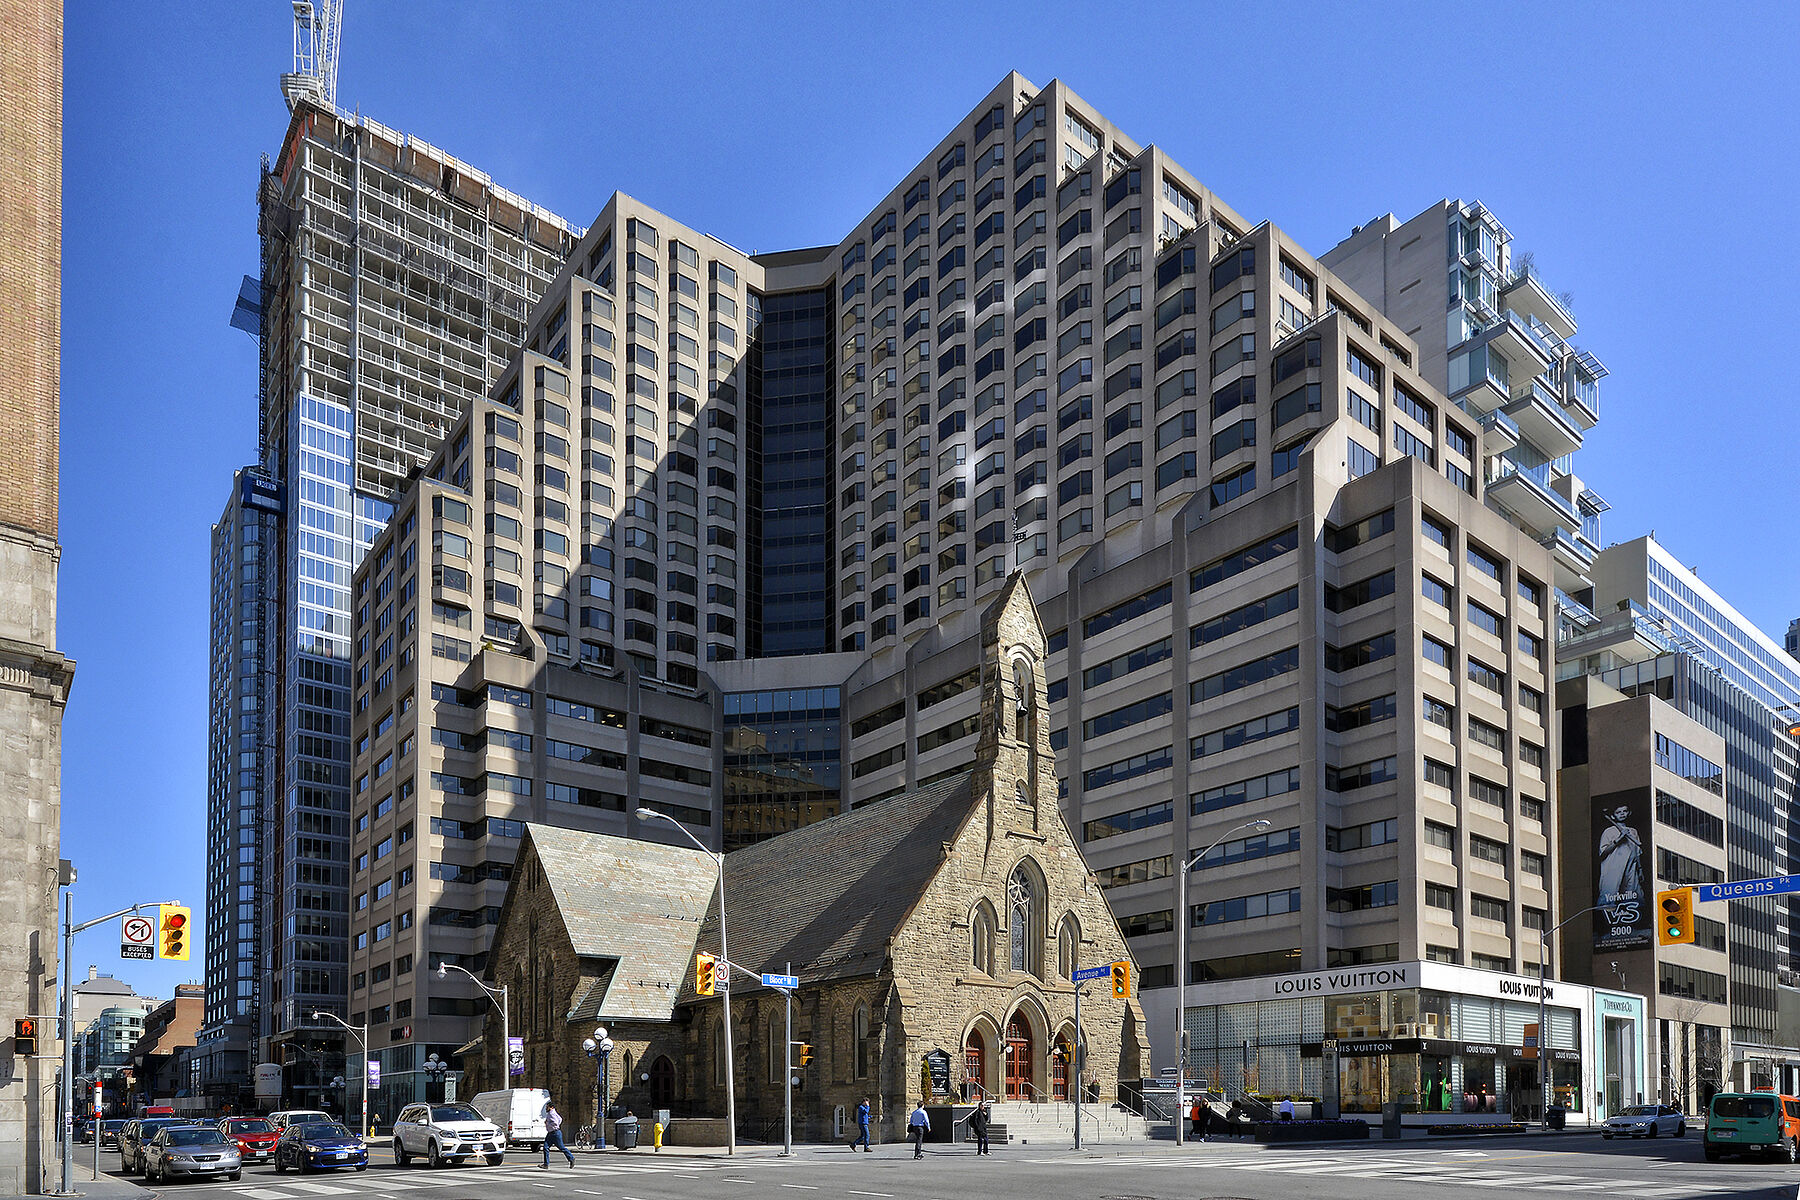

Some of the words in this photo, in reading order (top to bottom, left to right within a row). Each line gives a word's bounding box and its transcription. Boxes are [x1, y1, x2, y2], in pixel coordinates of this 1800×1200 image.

[1711, 881, 1774, 898] Queens
[1605, 891, 1638, 902] Yorkville
[1611, 926, 1632, 936] 5000
[1077, 970, 1099, 979] Avenue
[769, 975, 783, 985] Bloor
[1275, 977, 1322, 994] LOUIS
[1328, 969, 1406, 989] VUITTON
[1500, 980, 1521, 996] LOUIS
[1523, 984, 1553, 1000] VUITON
[1322, 1039, 1336, 1049] 150
[1353, 1043, 1392, 1052] VUITTON
[1466, 1045, 1479, 1054] LOUIS
[1479, 1046, 1497, 1055] VUITTON
